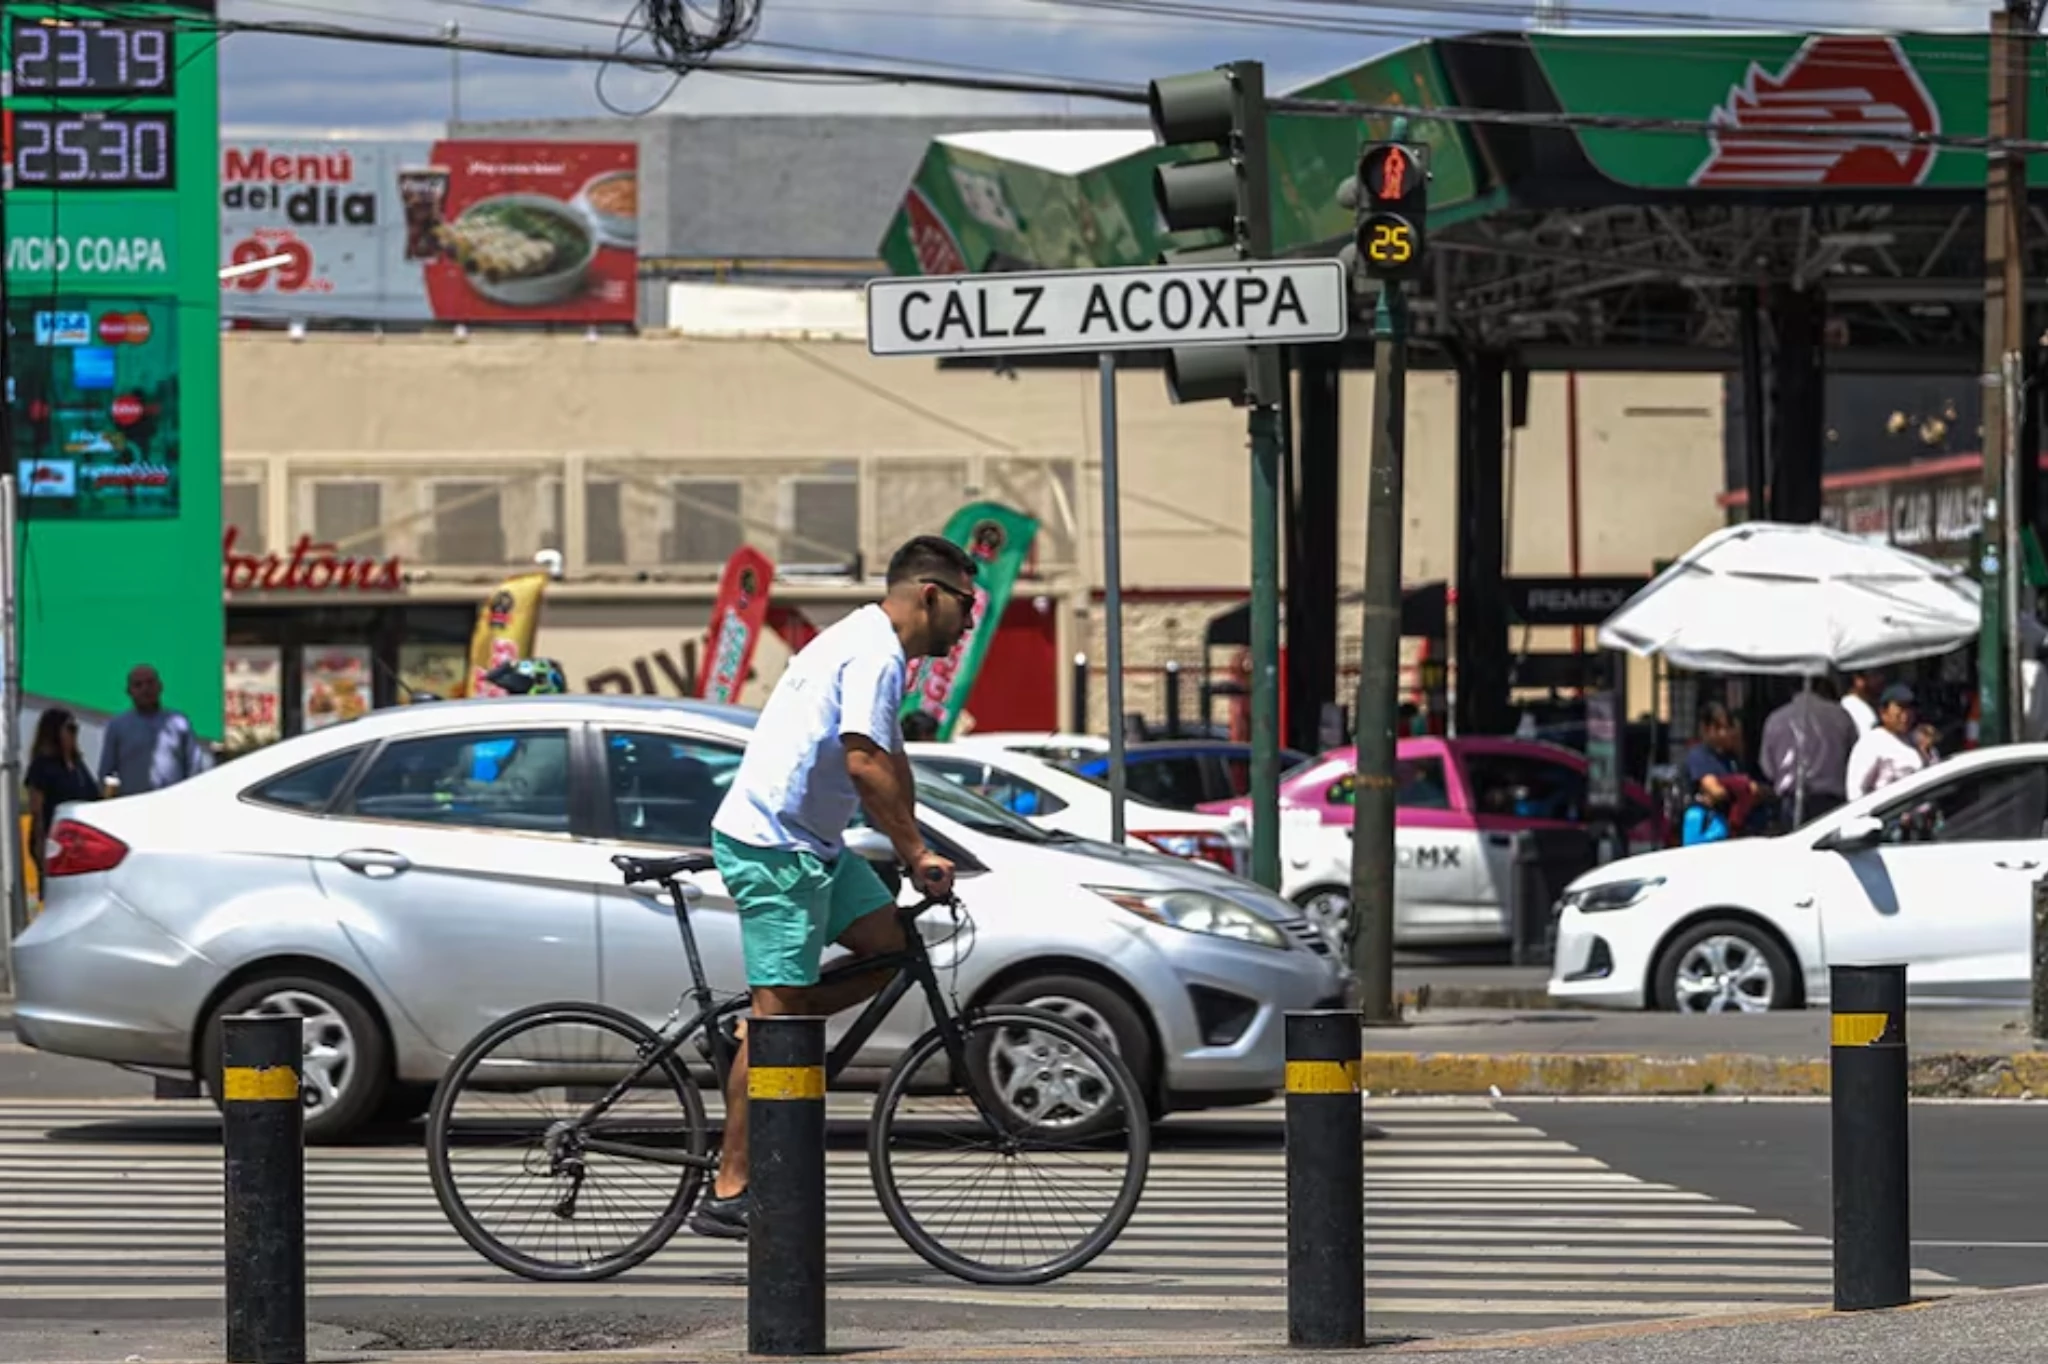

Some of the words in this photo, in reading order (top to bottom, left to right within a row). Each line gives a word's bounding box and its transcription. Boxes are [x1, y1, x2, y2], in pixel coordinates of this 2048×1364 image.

[17, 29, 165, 87] 23.79
[18, 122, 167, 180] 25.30
[223, 185, 279, 209] del
[75, 236, 166, 271] COAPA
[1369, 225, 1411, 261] 25
[899, 285, 1046, 342] CALZ
[1079, 275, 1308, 334] ACOXPA
